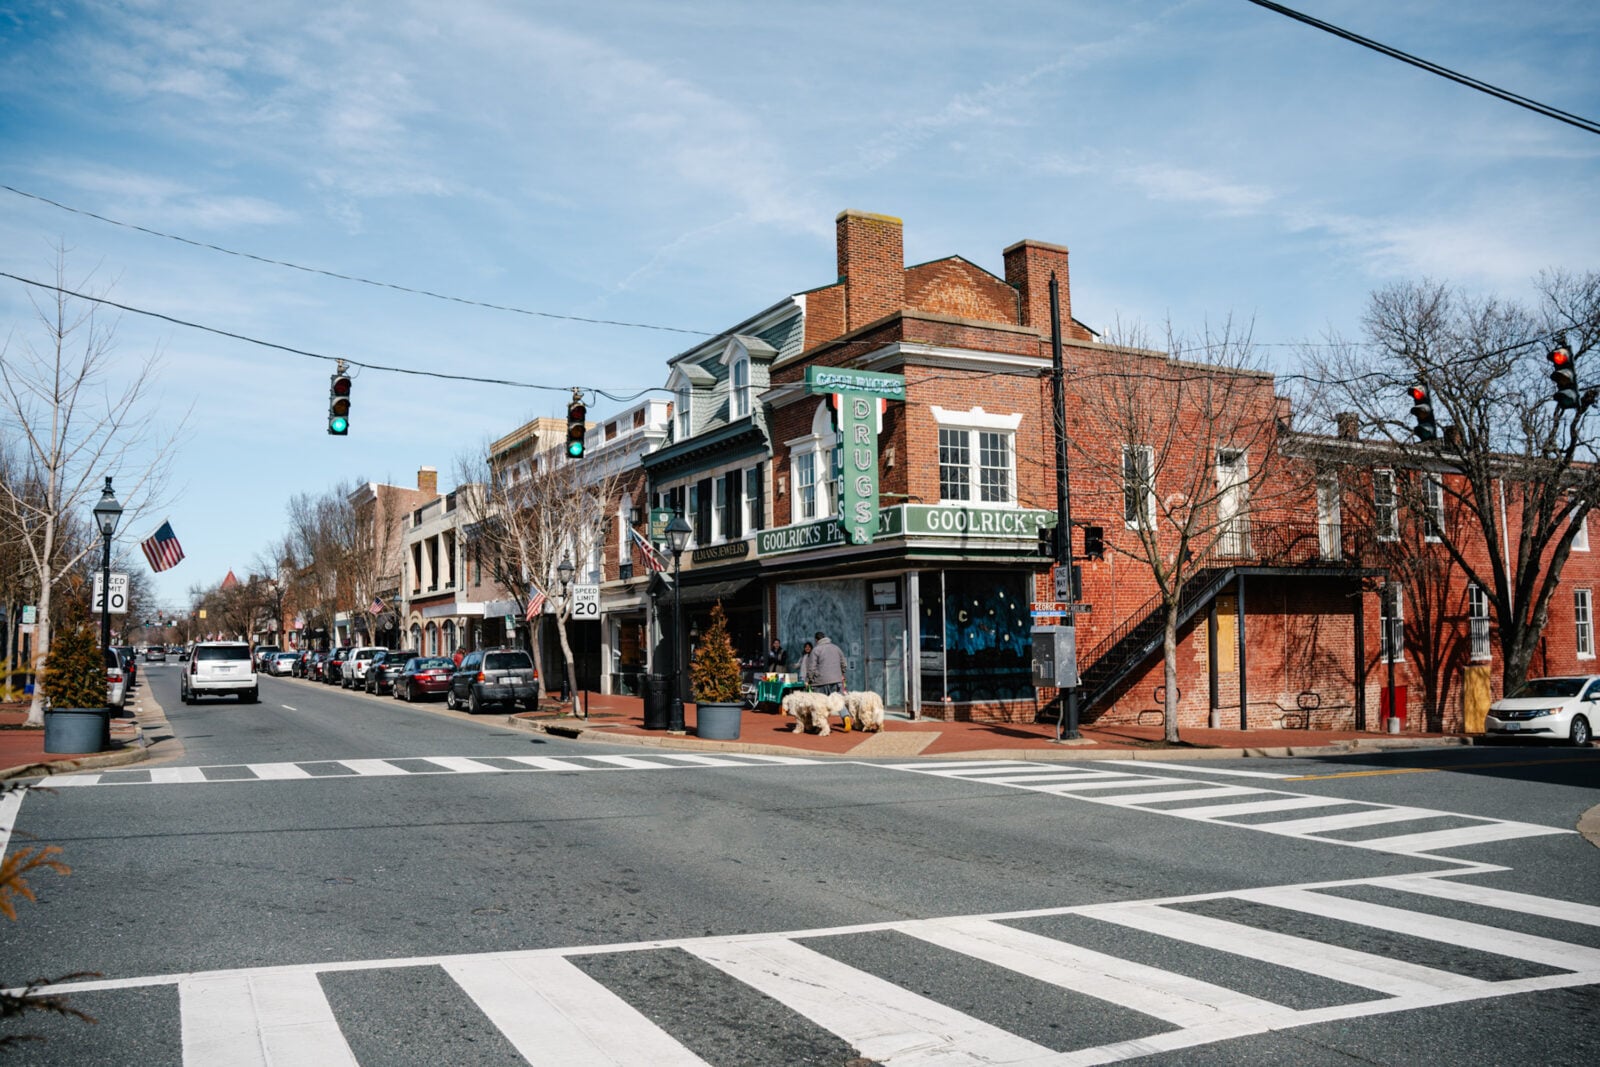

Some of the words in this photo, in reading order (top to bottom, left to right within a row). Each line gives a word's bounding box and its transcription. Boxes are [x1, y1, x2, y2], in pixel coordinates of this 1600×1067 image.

[816, 373, 902, 394] GOOLRICK'S
[853, 398, 872, 524] DRUGS
[927, 510, 1046, 533] GOOLRICK'S
[763, 525, 820, 551] GOOLRICK'S
[1056, 568, 1066, 578] ONE
[1057, 580, 1066, 588] WAY
[575, 602, 597, 614] 20
[1034, 603, 1056, 611] GEORGE
